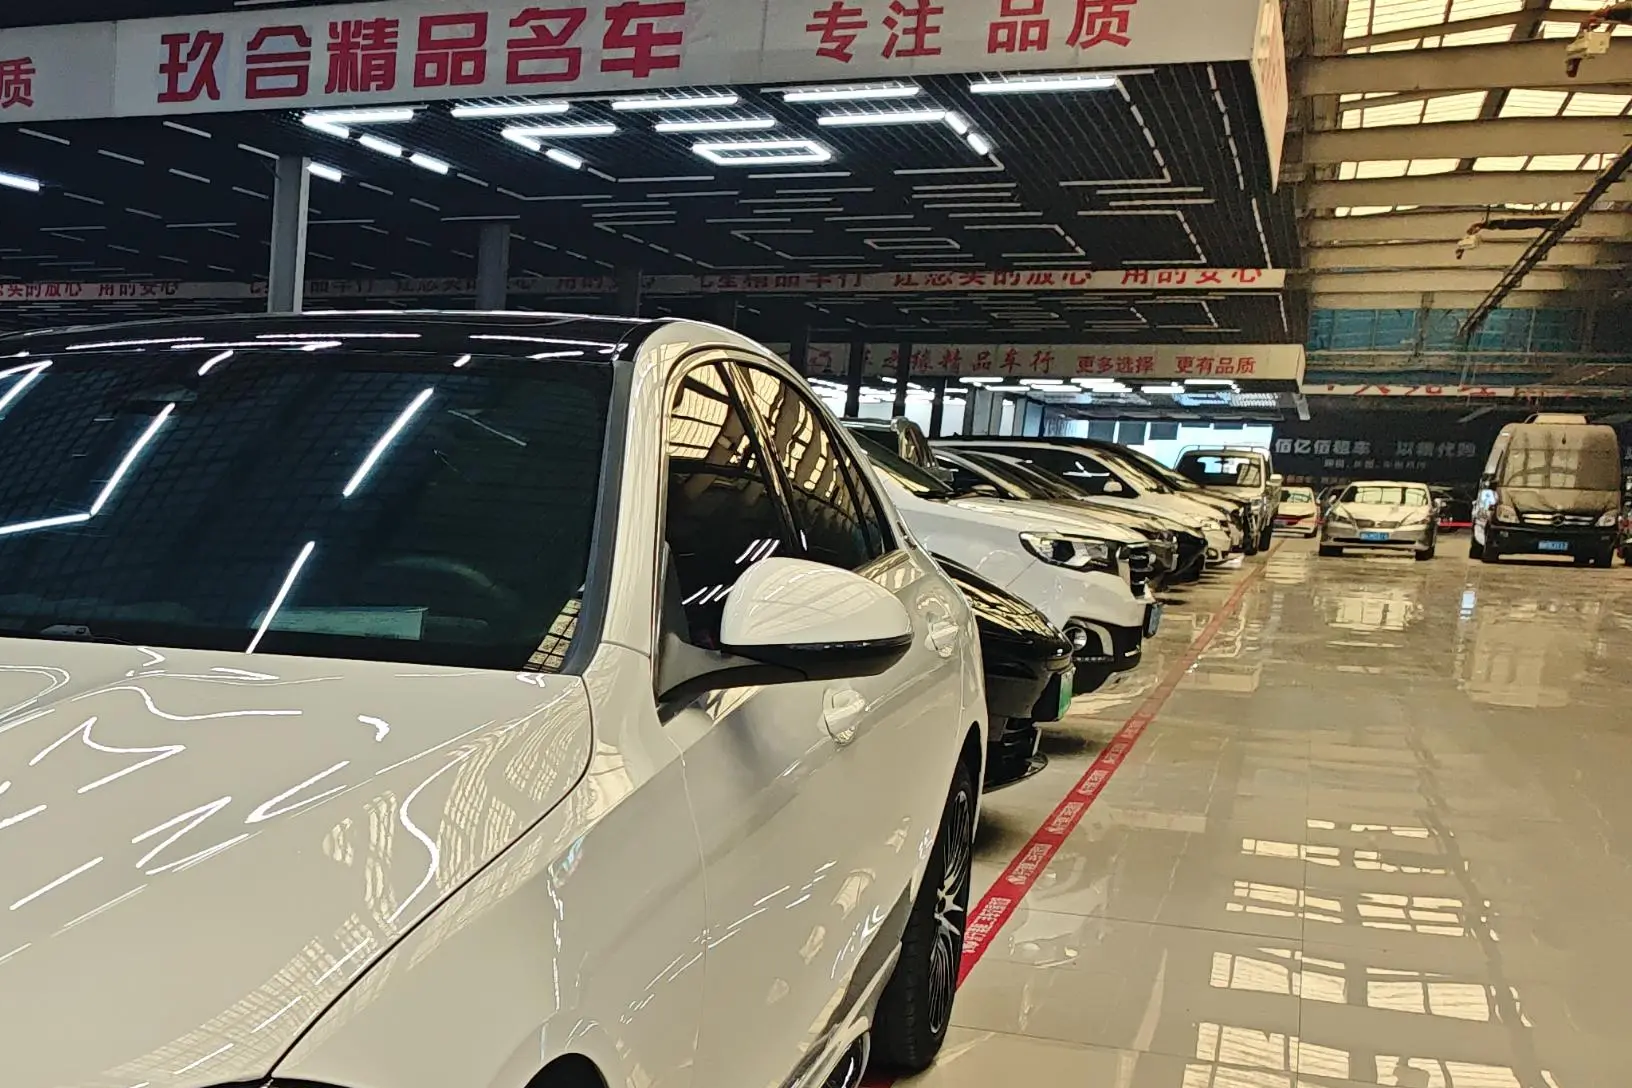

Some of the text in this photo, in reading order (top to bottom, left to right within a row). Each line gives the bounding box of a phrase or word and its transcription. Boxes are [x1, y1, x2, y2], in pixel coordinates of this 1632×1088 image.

[157, 0, 1138, 103] 玖合精品名车 专注 品质
[1076, 356, 1156, 374] 更多选择
[1175, 356, 1257, 374] 更有品质
